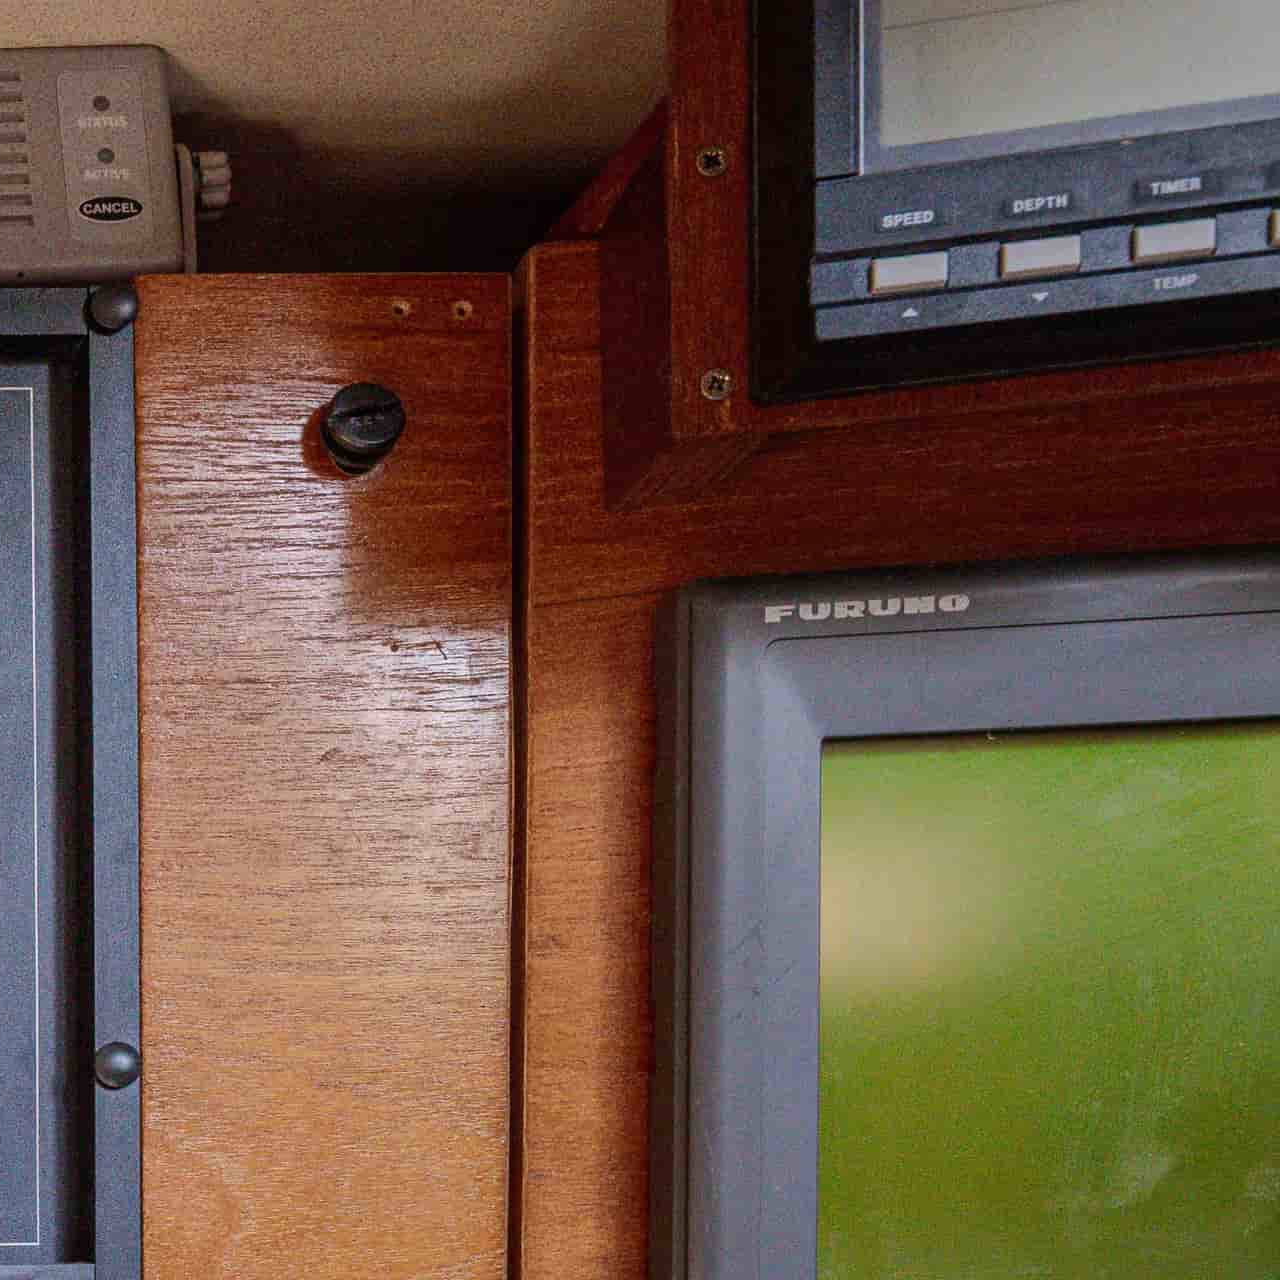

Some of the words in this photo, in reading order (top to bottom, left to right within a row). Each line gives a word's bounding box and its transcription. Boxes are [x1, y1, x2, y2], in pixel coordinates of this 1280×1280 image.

[1150, 177, 1201, 195] TIMER
[82, 201, 138, 215] CANCEL
[1013, 194, 1068, 214] DEPTH
[882, 209, 934, 229] SPEED
[1153, 273, 1198, 291] TEMP
[765, 593, 970, 623] FURUNO
